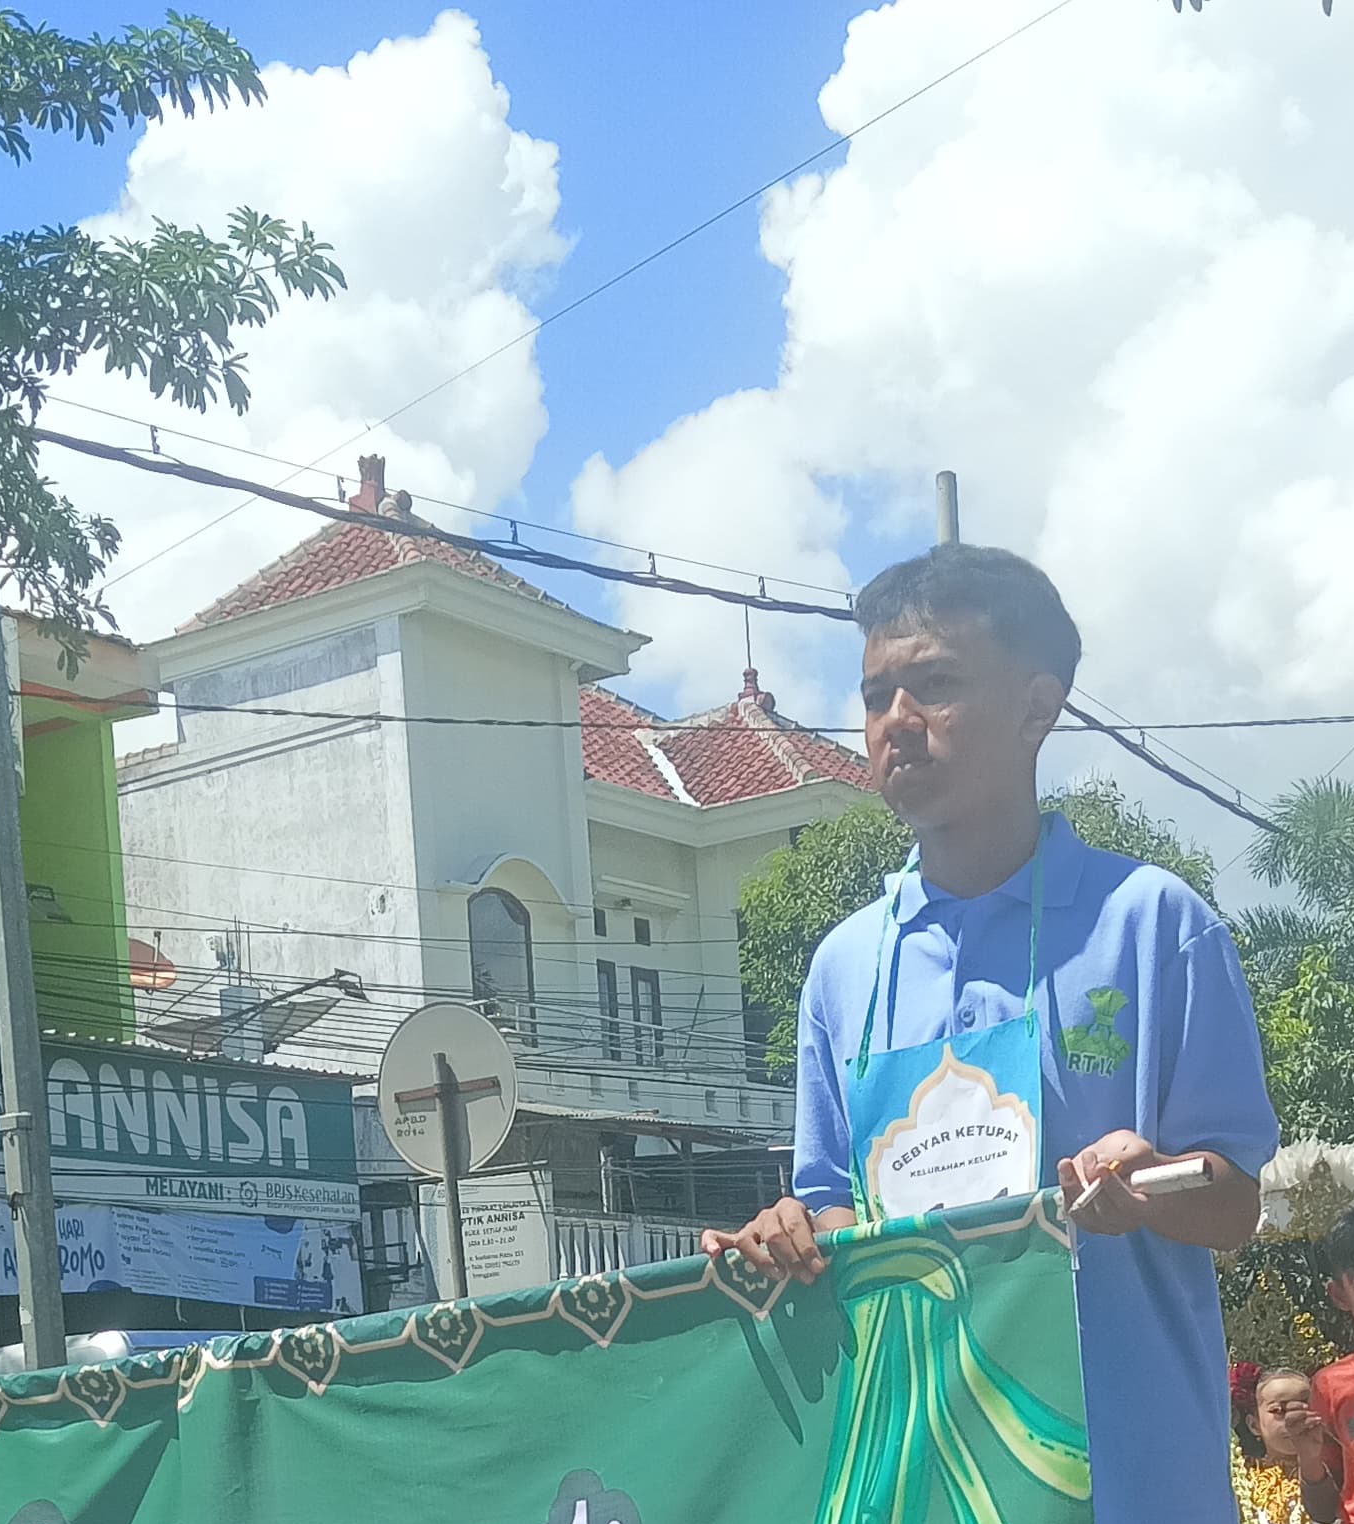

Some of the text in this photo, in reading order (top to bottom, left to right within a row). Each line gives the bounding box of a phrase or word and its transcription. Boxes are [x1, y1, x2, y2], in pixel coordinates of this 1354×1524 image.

[1067, 1051, 1097, 1073] RT
[47, 1058, 310, 1170] ANNISA
[891, 1125, 1020, 1172] GEBYAR KETUPAT
[58, 1217, 85, 1241] HARI
[486, 1212, 525, 1225] ANNISA
[58, 1243, 105, 1280] ROMO
